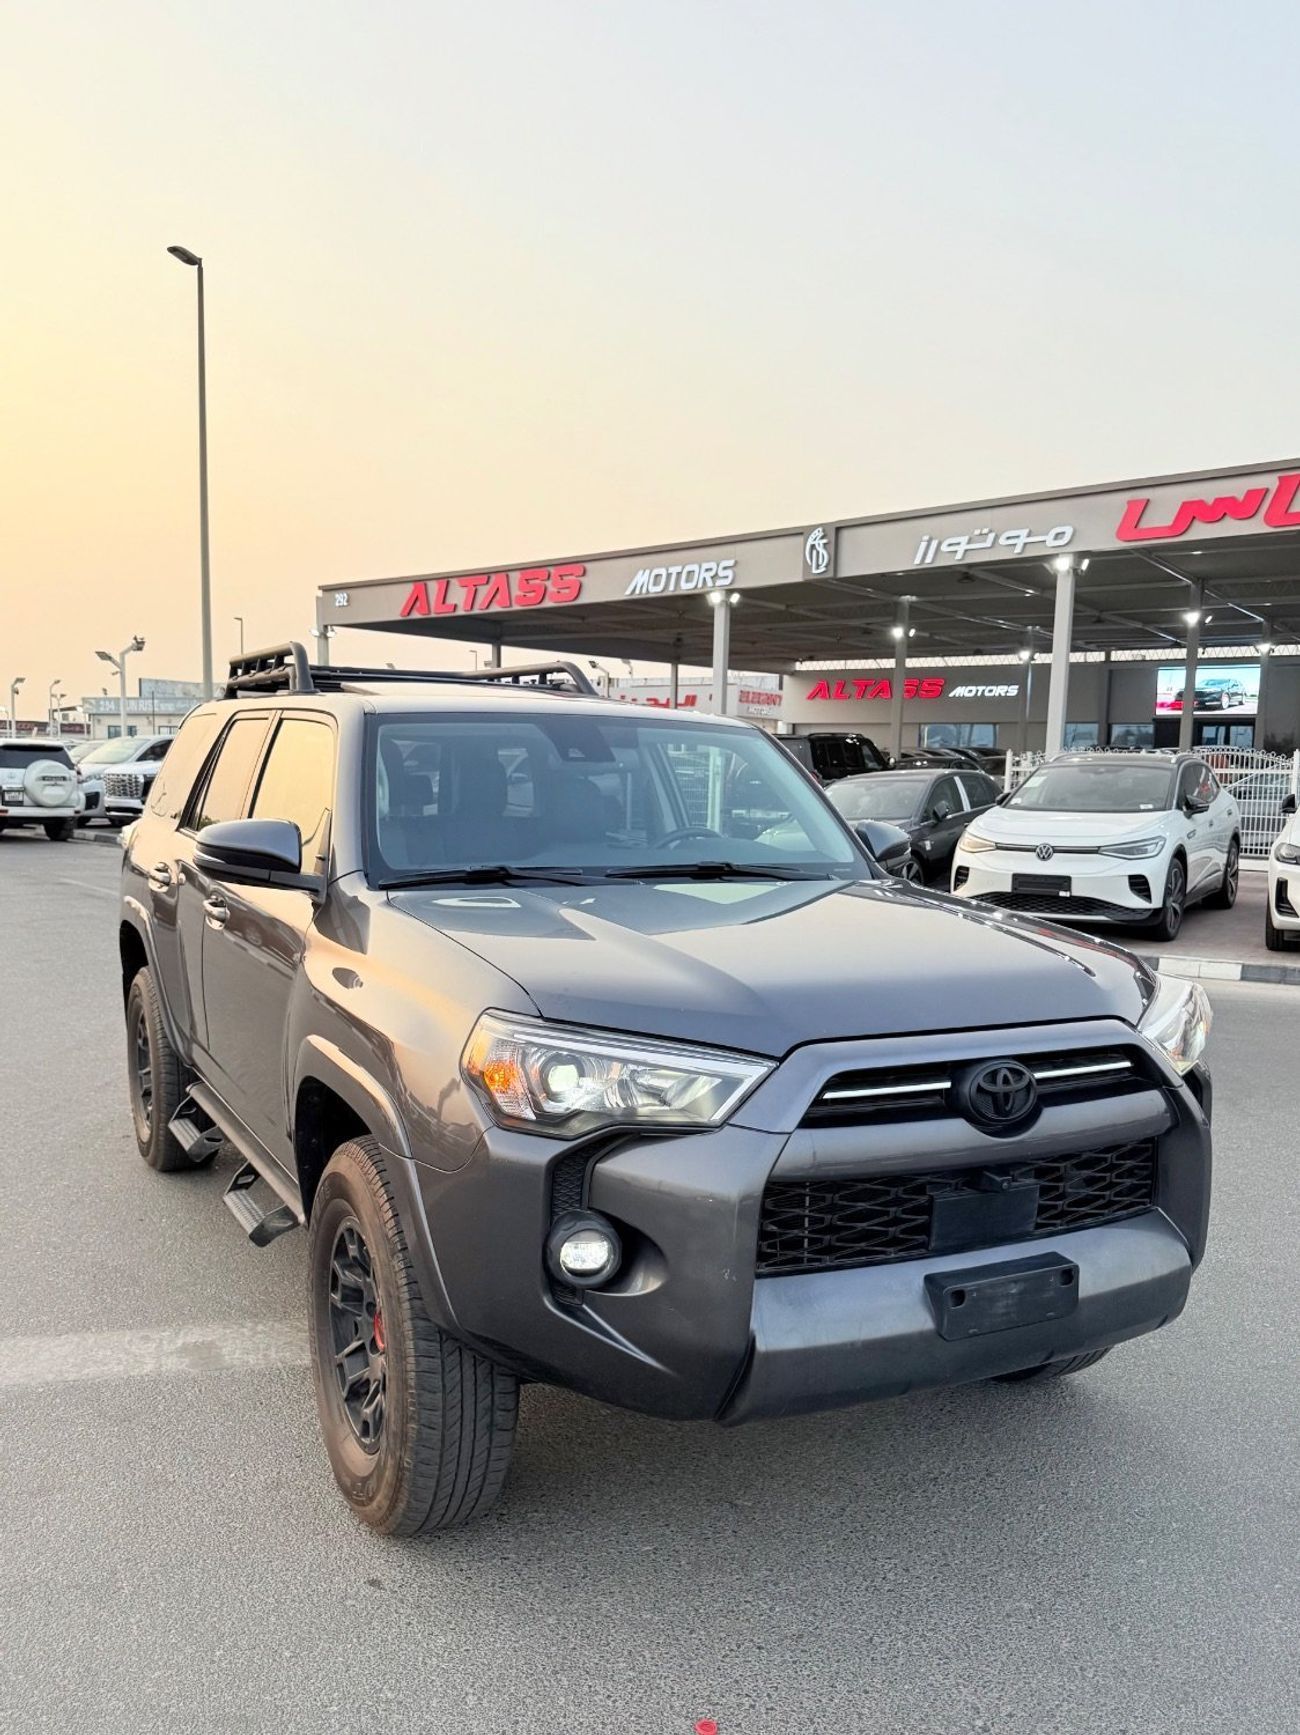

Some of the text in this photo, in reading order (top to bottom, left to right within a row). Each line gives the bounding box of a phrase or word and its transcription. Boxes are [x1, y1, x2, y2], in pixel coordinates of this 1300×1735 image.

[335, 592, 349, 607] 292
[400, 559, 736, 618] ALTASS MOTORS
[806, 678, 1020, 700] ALTASS MOTORS
